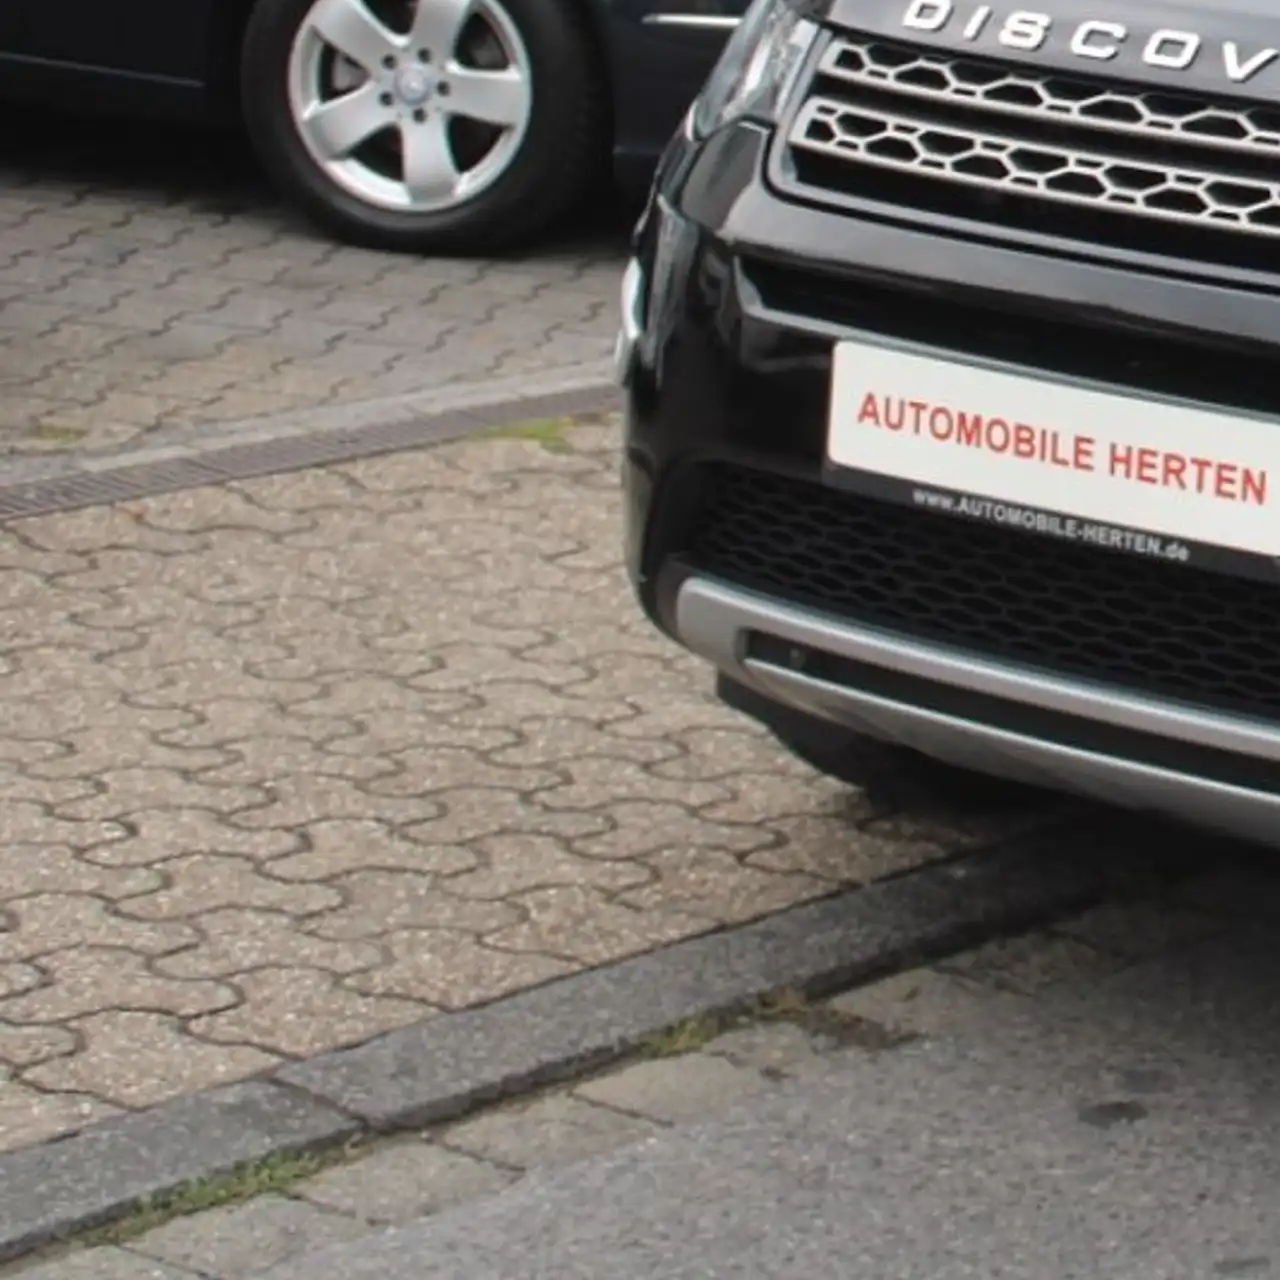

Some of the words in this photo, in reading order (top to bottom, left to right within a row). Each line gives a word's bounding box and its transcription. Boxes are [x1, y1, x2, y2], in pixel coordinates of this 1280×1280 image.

[857, 392, 1095, 470] AUTOMOBILE
[1109, 442, 1267, 506] HERTEN
[911, 488, 1191, 562] www.AUTOMOBILE-HERTEN.de
